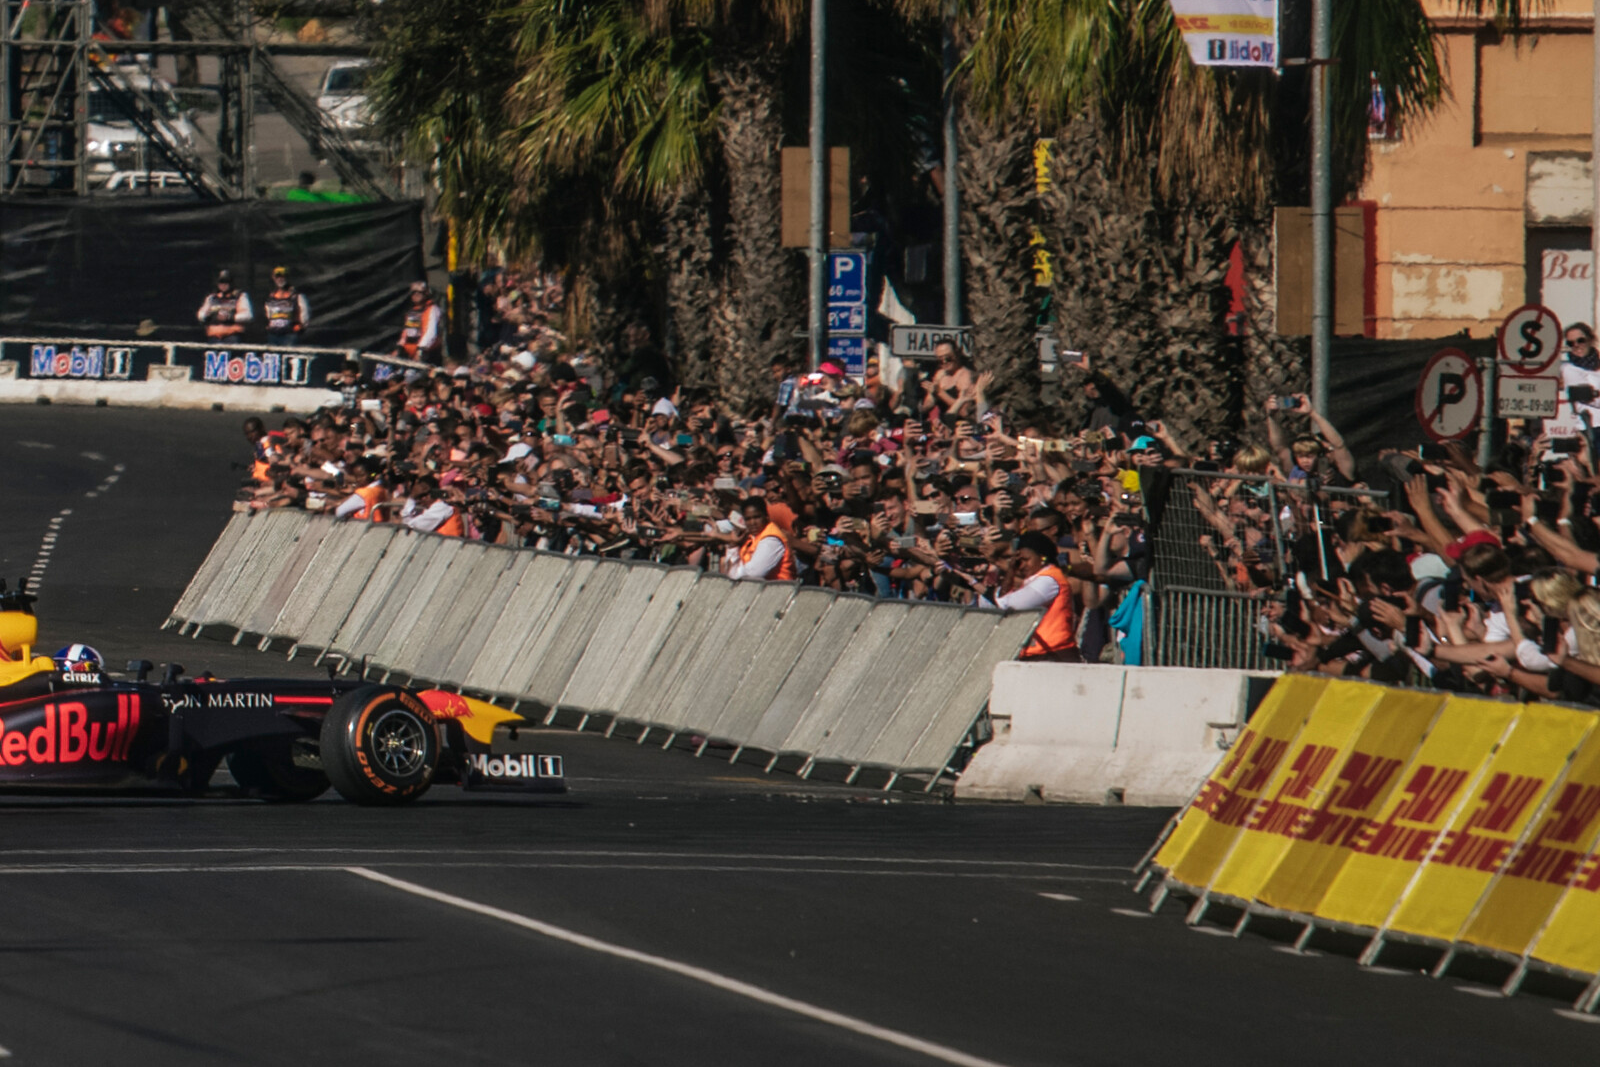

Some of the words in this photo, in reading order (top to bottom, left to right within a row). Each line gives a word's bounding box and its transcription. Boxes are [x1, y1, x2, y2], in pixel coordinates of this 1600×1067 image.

[835, 257, 855, 279] P
[1518, 320, 1544, 358] S
[31, 345, 103, 377] Mobil
[205, 351, 279, 384] Mobil
[208, 693, 273, 708] MARTIN
[470, 754, 536, 777] Mobil
